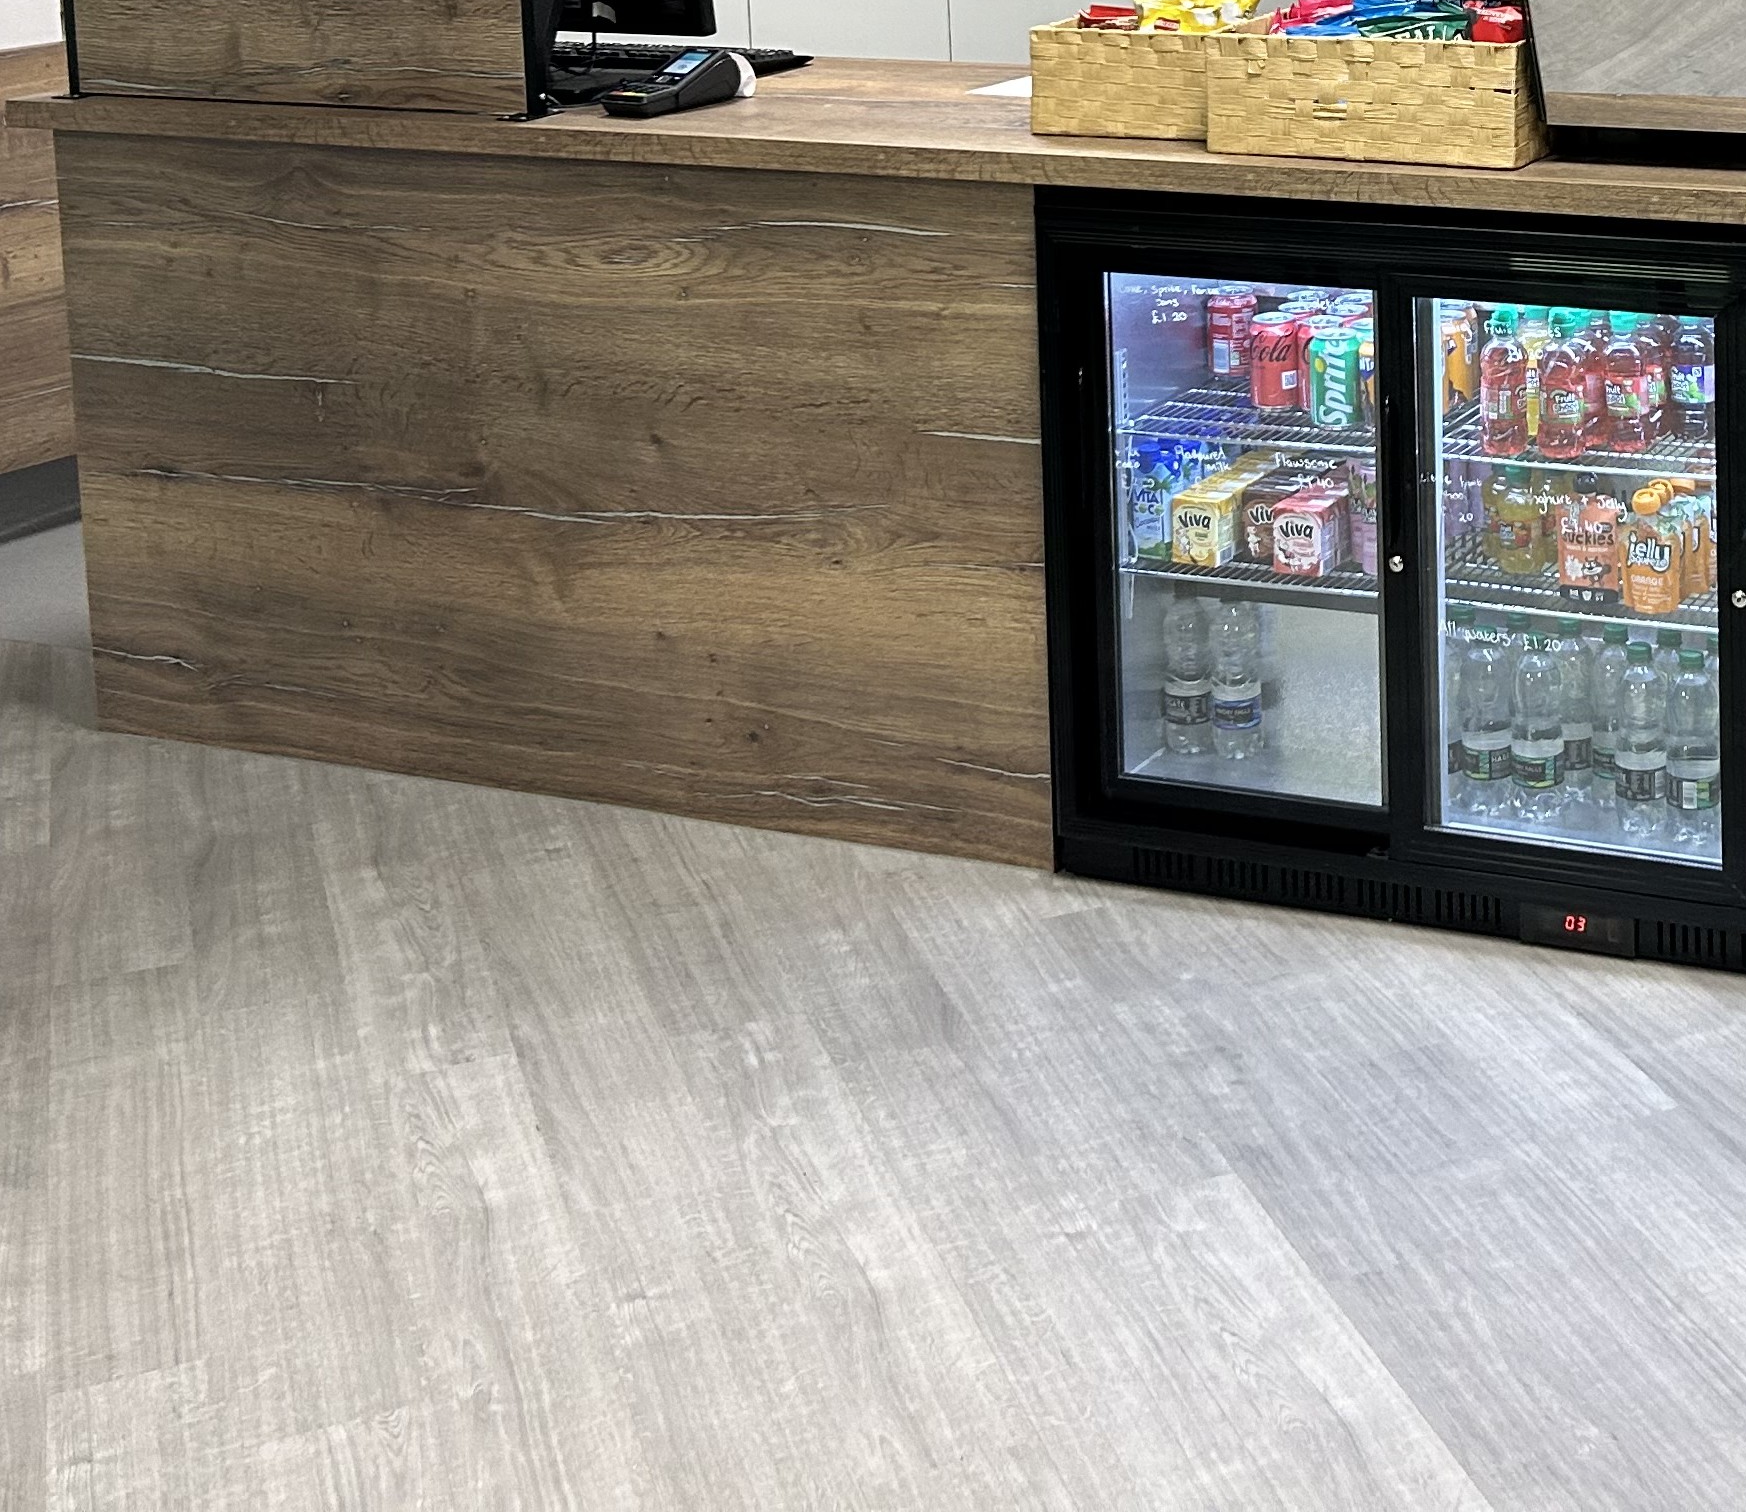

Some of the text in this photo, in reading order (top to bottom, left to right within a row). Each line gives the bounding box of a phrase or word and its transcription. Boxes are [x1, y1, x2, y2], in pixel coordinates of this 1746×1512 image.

[1318, 339, 1354, 426] Sprite
[1134, 488, 1160, 504] VITA
[1248, 505, 1275, 525] Viv
[1597, 494, 1628, 522] Jelly
[1178, 510, 1212, 530] Viva
[1280, 520, 1314, 540] Viva
[1627, 530, 1672, 573] jelly
[1564, 915, 1586, 932] 03
